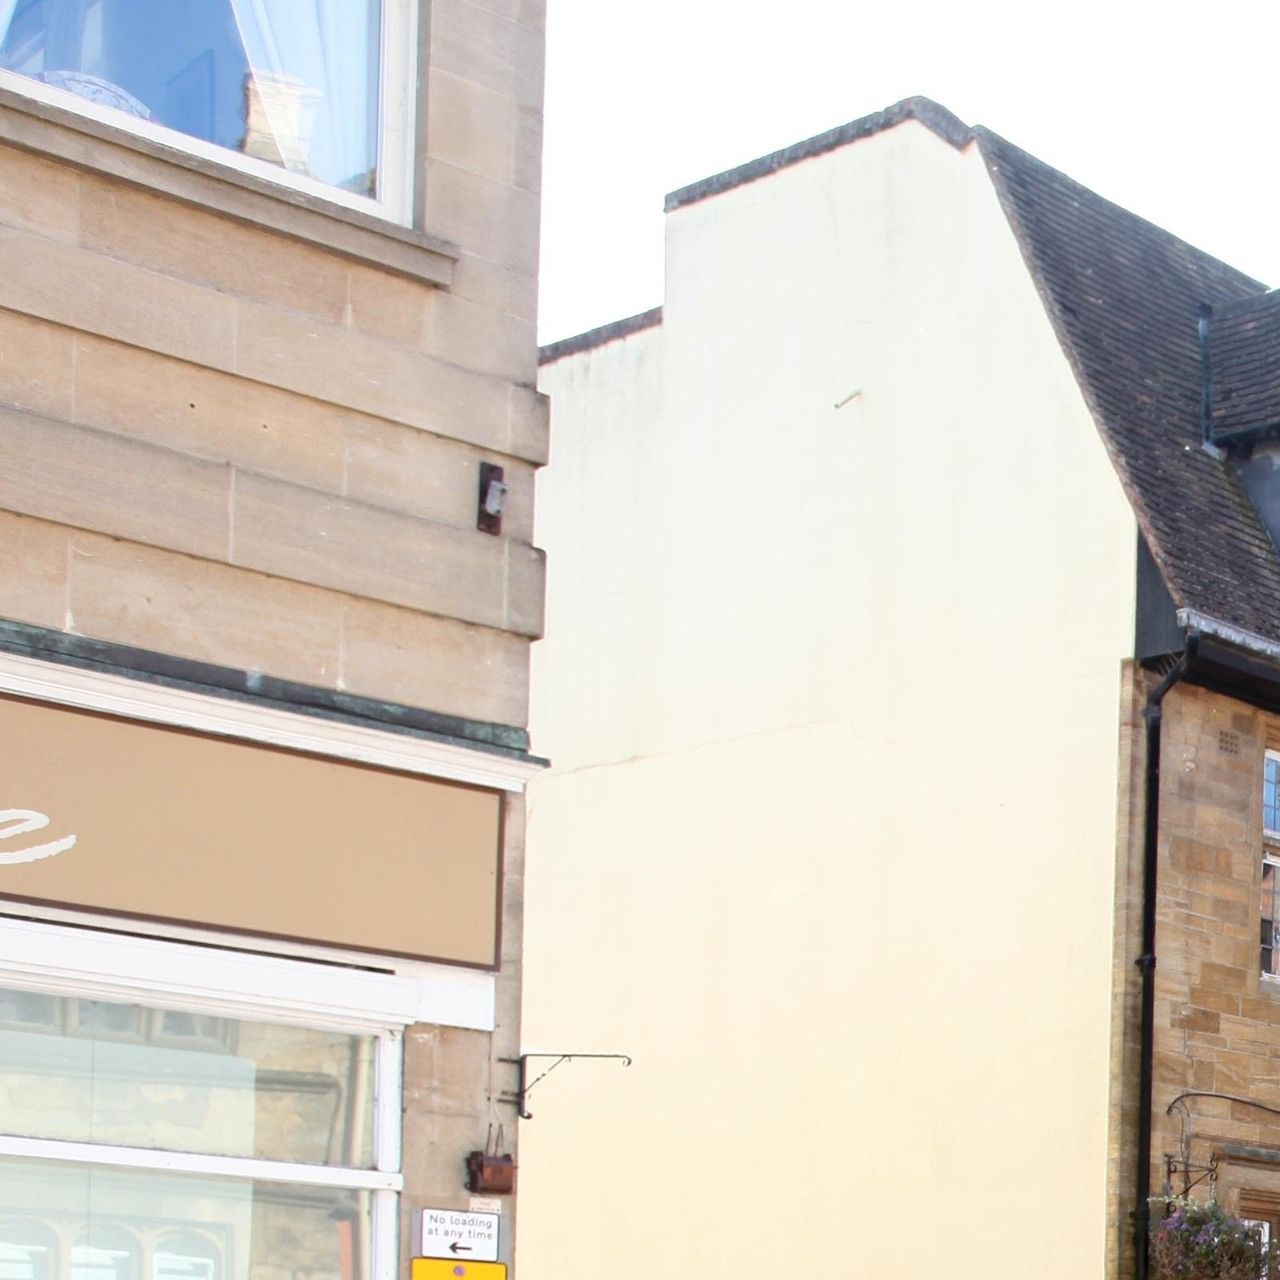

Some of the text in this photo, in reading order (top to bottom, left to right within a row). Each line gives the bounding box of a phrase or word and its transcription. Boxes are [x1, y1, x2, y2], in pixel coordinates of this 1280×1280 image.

[429, 1214, 493, 1229] No loading
[427, 1227, 493, 1240] at any time
